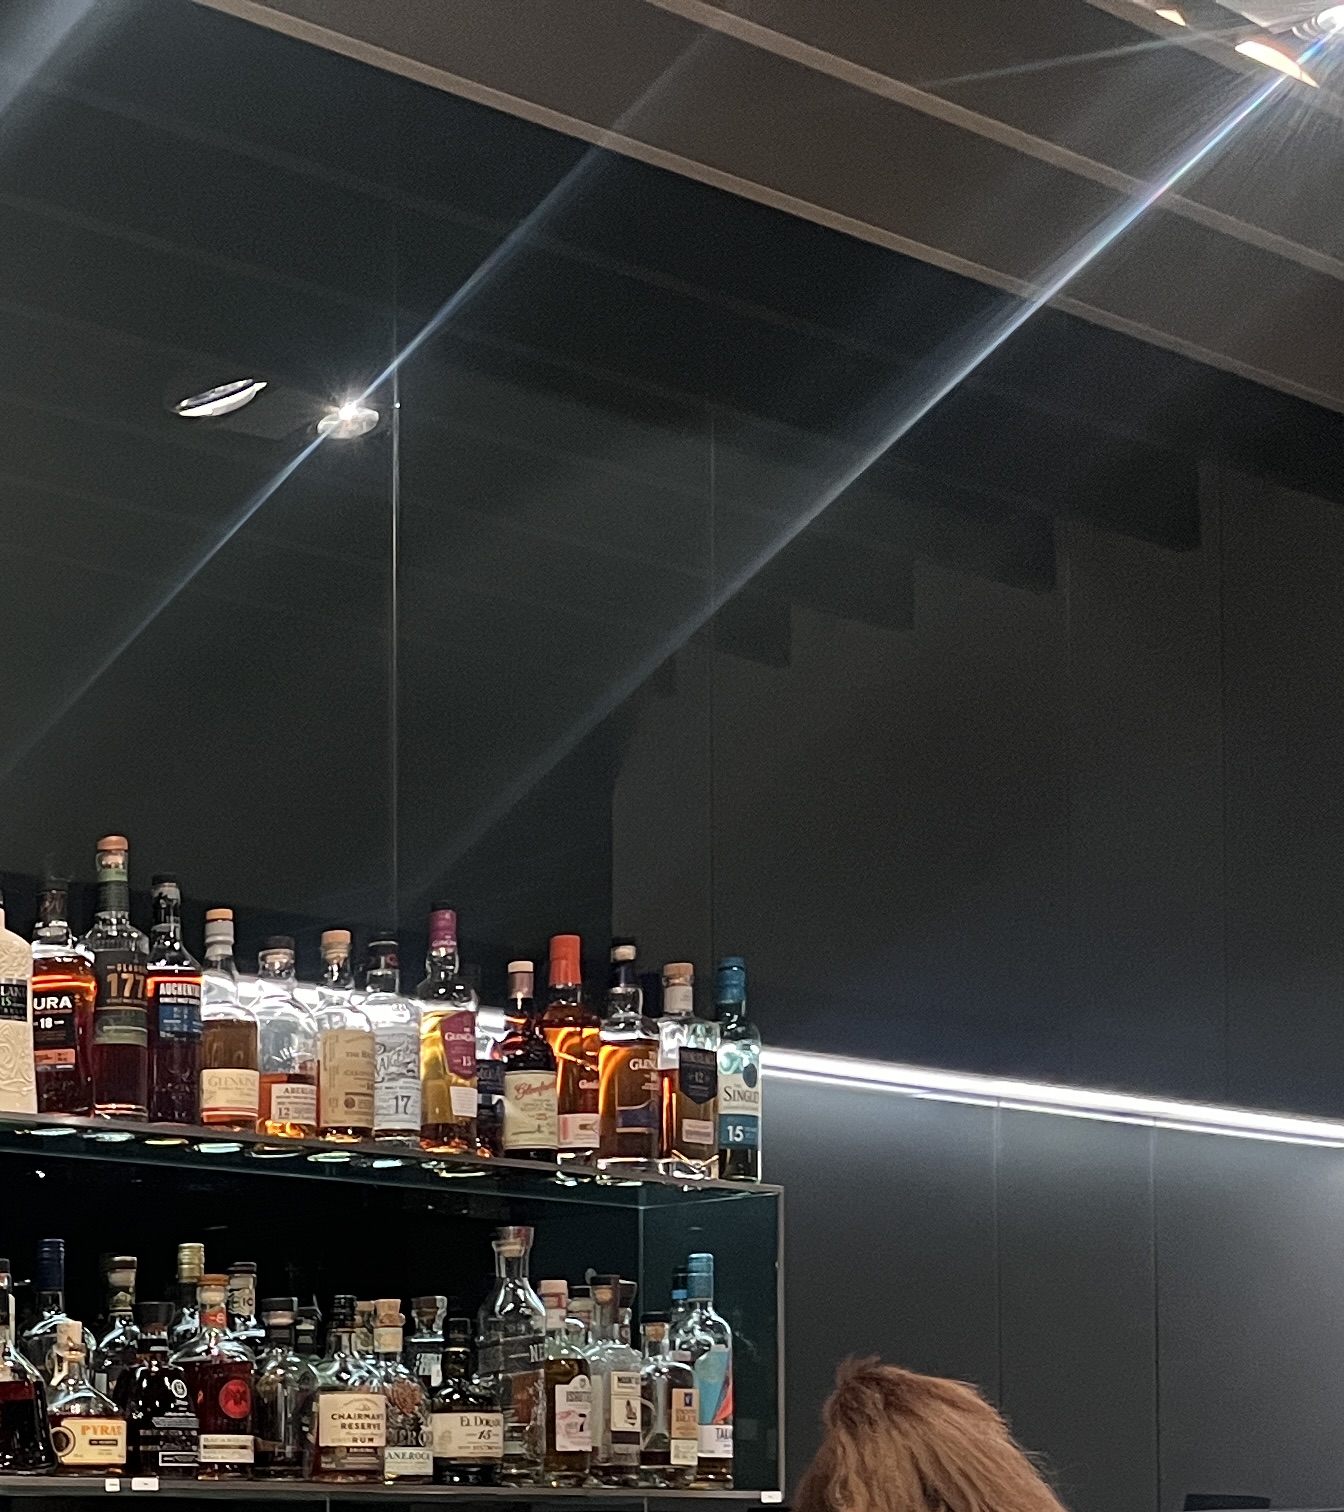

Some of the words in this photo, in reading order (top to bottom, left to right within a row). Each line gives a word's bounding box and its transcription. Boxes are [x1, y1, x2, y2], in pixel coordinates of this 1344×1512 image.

[39, 1017, 53, 1029] 18
[393, 1094, 411, 1116] 17
[278, 1106, 291, 1119] 12
[726, 1124, 745, 1143] 15
[340, 1422, 382, 1431] RESERVE
[351, 1435, 375, 1444] RUM
[477, 1429, 491, 1444] 15
